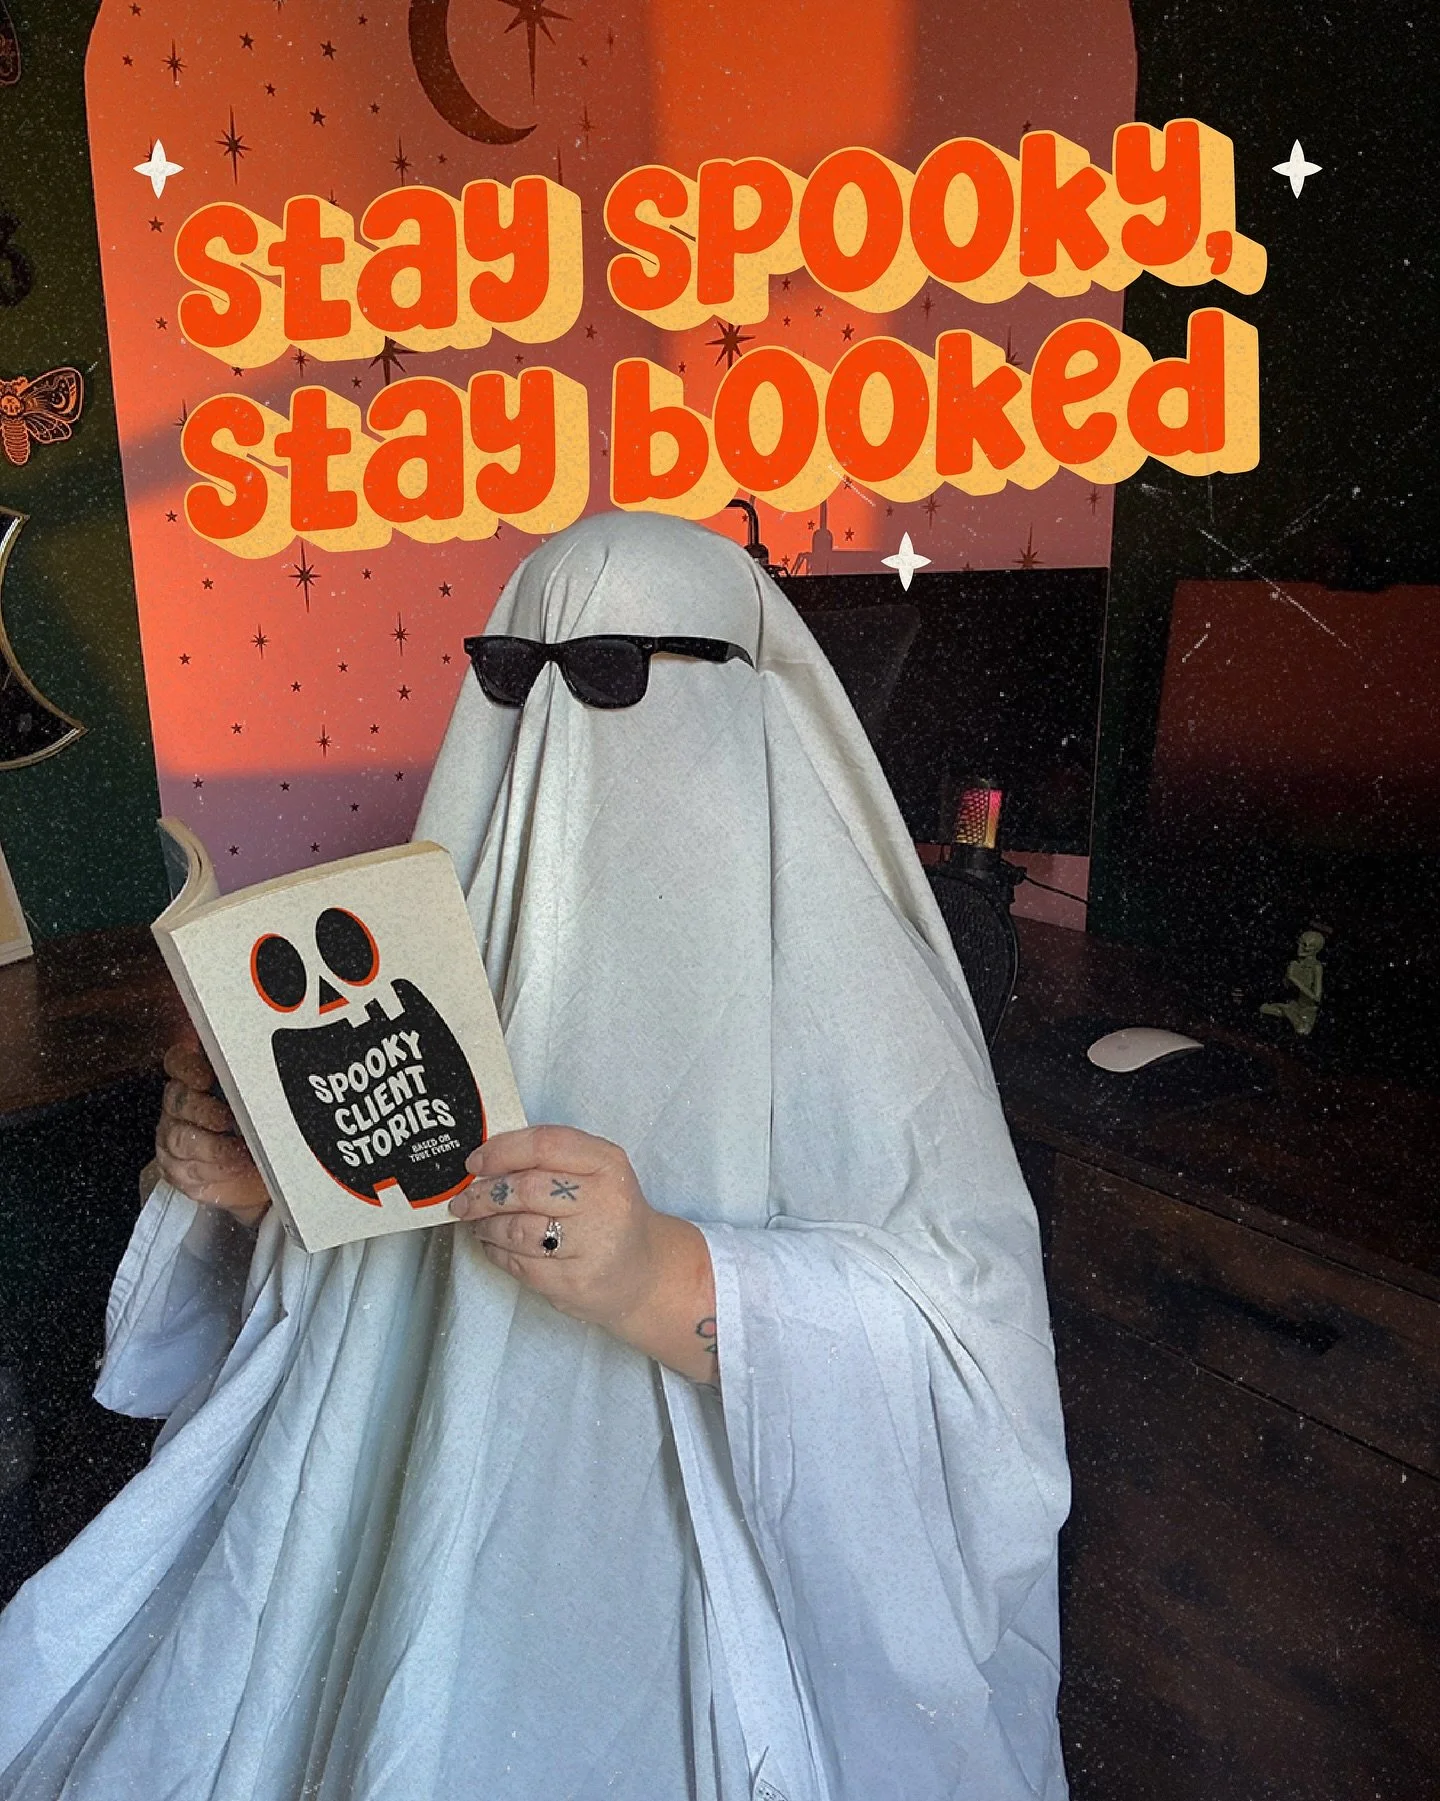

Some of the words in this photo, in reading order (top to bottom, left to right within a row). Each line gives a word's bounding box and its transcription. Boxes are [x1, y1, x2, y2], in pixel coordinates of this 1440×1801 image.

[308, 1030, 423, 1104] SPOOKY
[334, 1064, 427, 1136] CLIENT
[336, 1098, 456, 1167] STORIES
[408, 1150, 431, 1163] TRUE
[431, 1139, 461, 1155] EVENTS
[411, 1138, 438, 1153] BASED
[438, 1133, 451, 1143] ON
